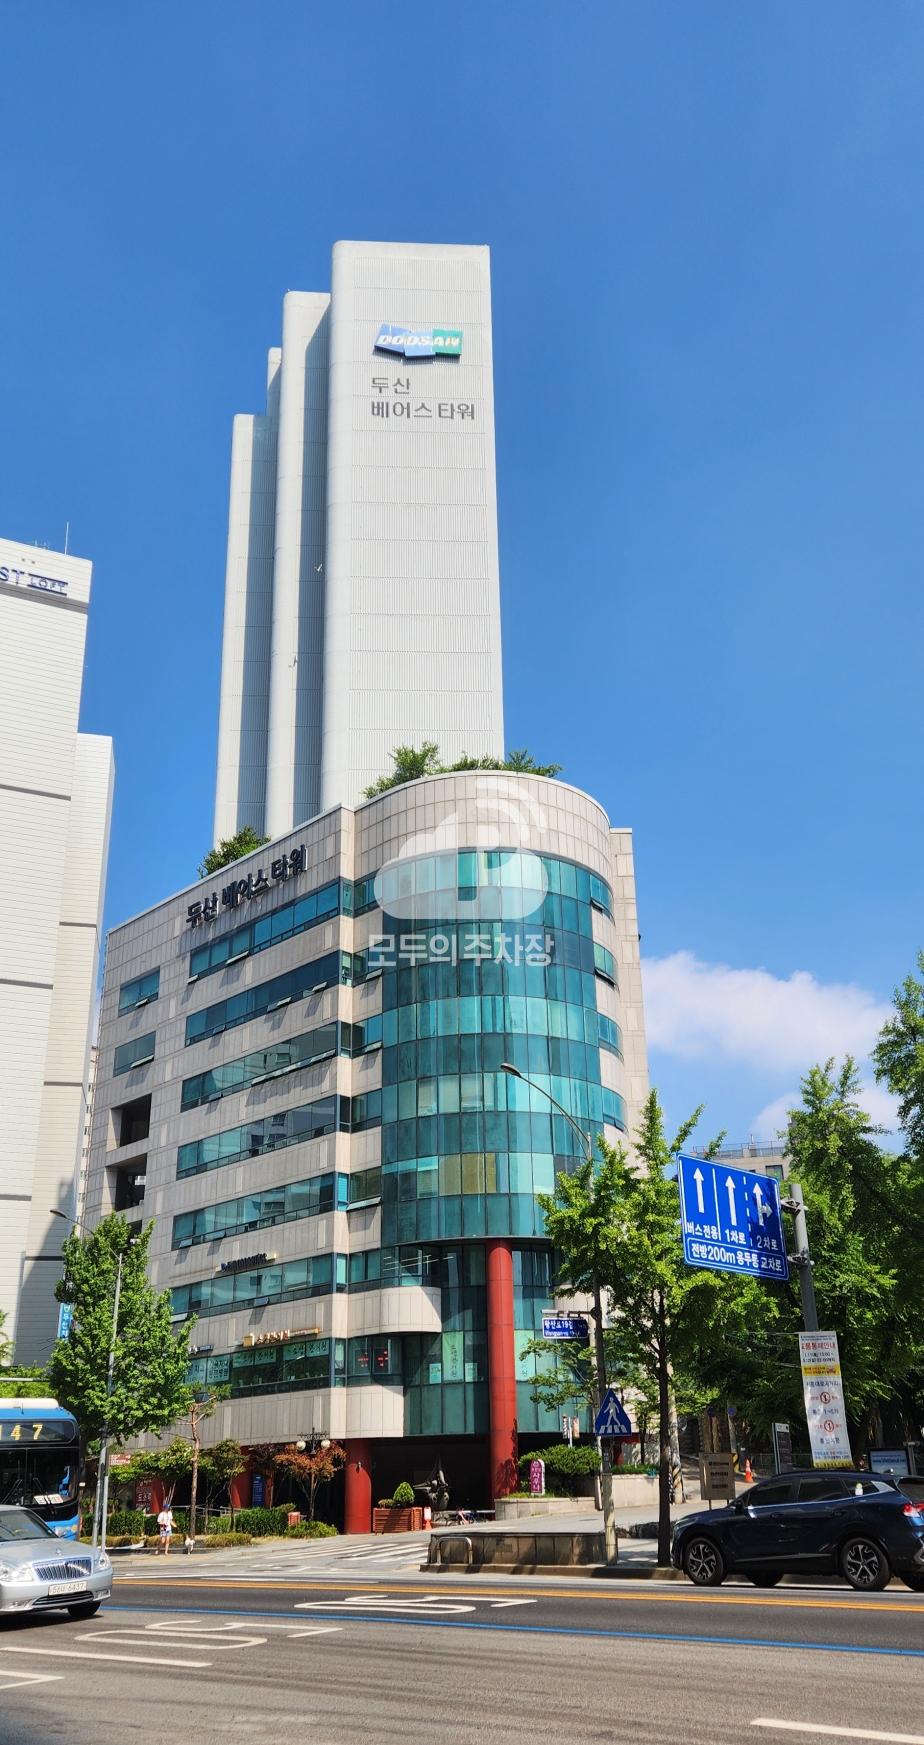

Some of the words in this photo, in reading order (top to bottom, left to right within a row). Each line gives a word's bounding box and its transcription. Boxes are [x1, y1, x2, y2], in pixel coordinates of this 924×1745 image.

[376, 335, 460, 346] DOOSAN
[371, 377, 411, 394] 두산
[186, 892, 218, 928] 두산
[687, 1221, 719, 1240] 버스전용
[725, 1229, 746, 1245] 1차로
[757, 1235, 778, 1251] 2차로
